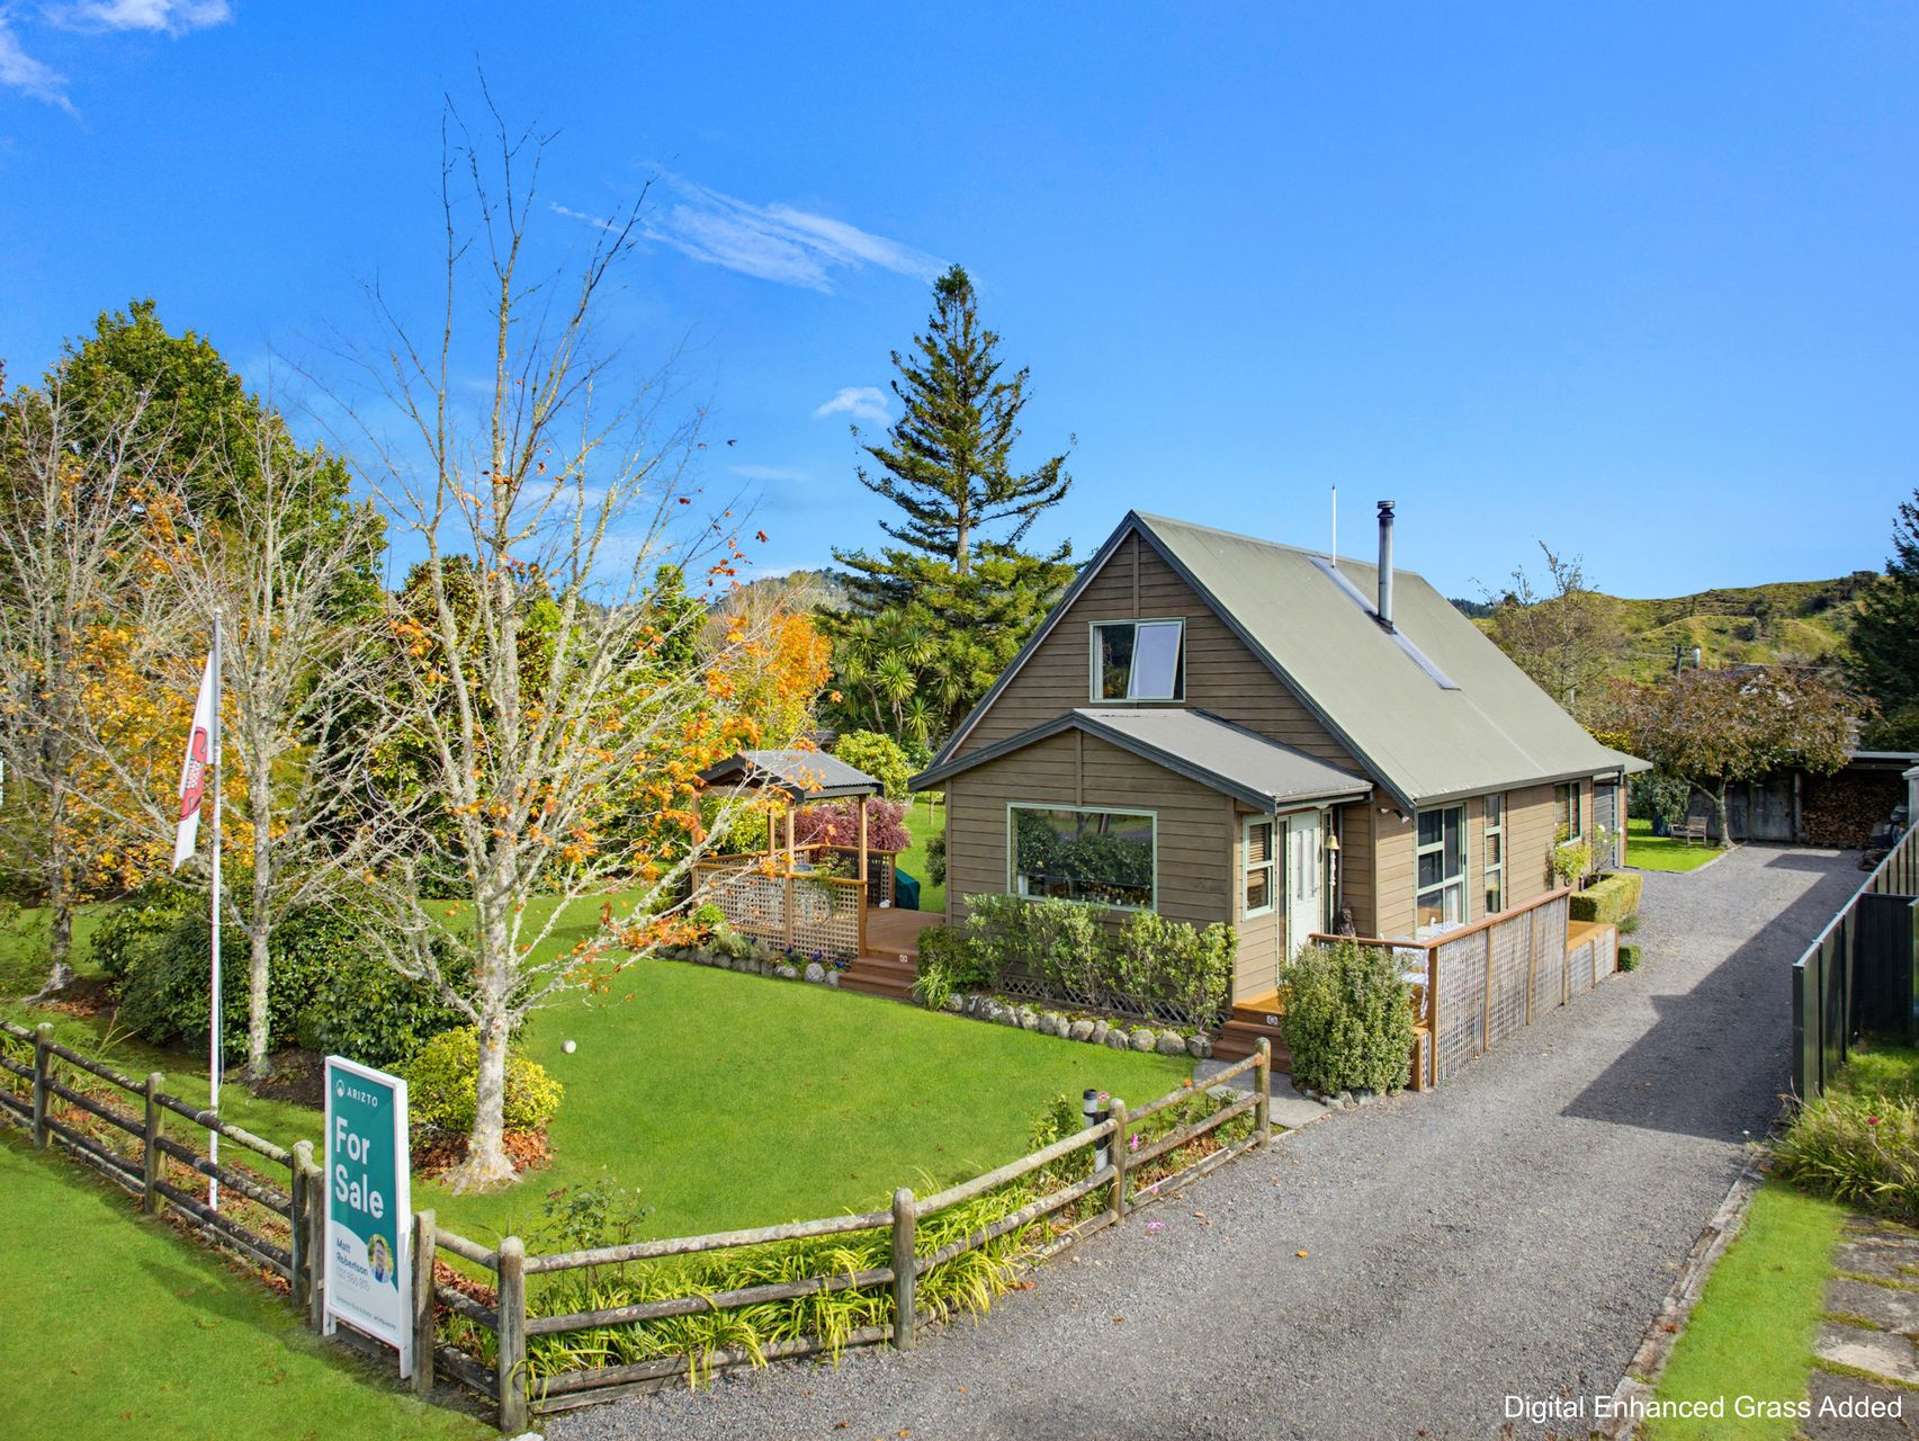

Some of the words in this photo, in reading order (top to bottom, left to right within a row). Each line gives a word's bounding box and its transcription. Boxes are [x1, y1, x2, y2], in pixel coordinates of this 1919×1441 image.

[346, 1087, 379, 1108] ARIZTO
[335, 1115, 371, 1165] For
[335, 1163, 384, 1219] Sale
